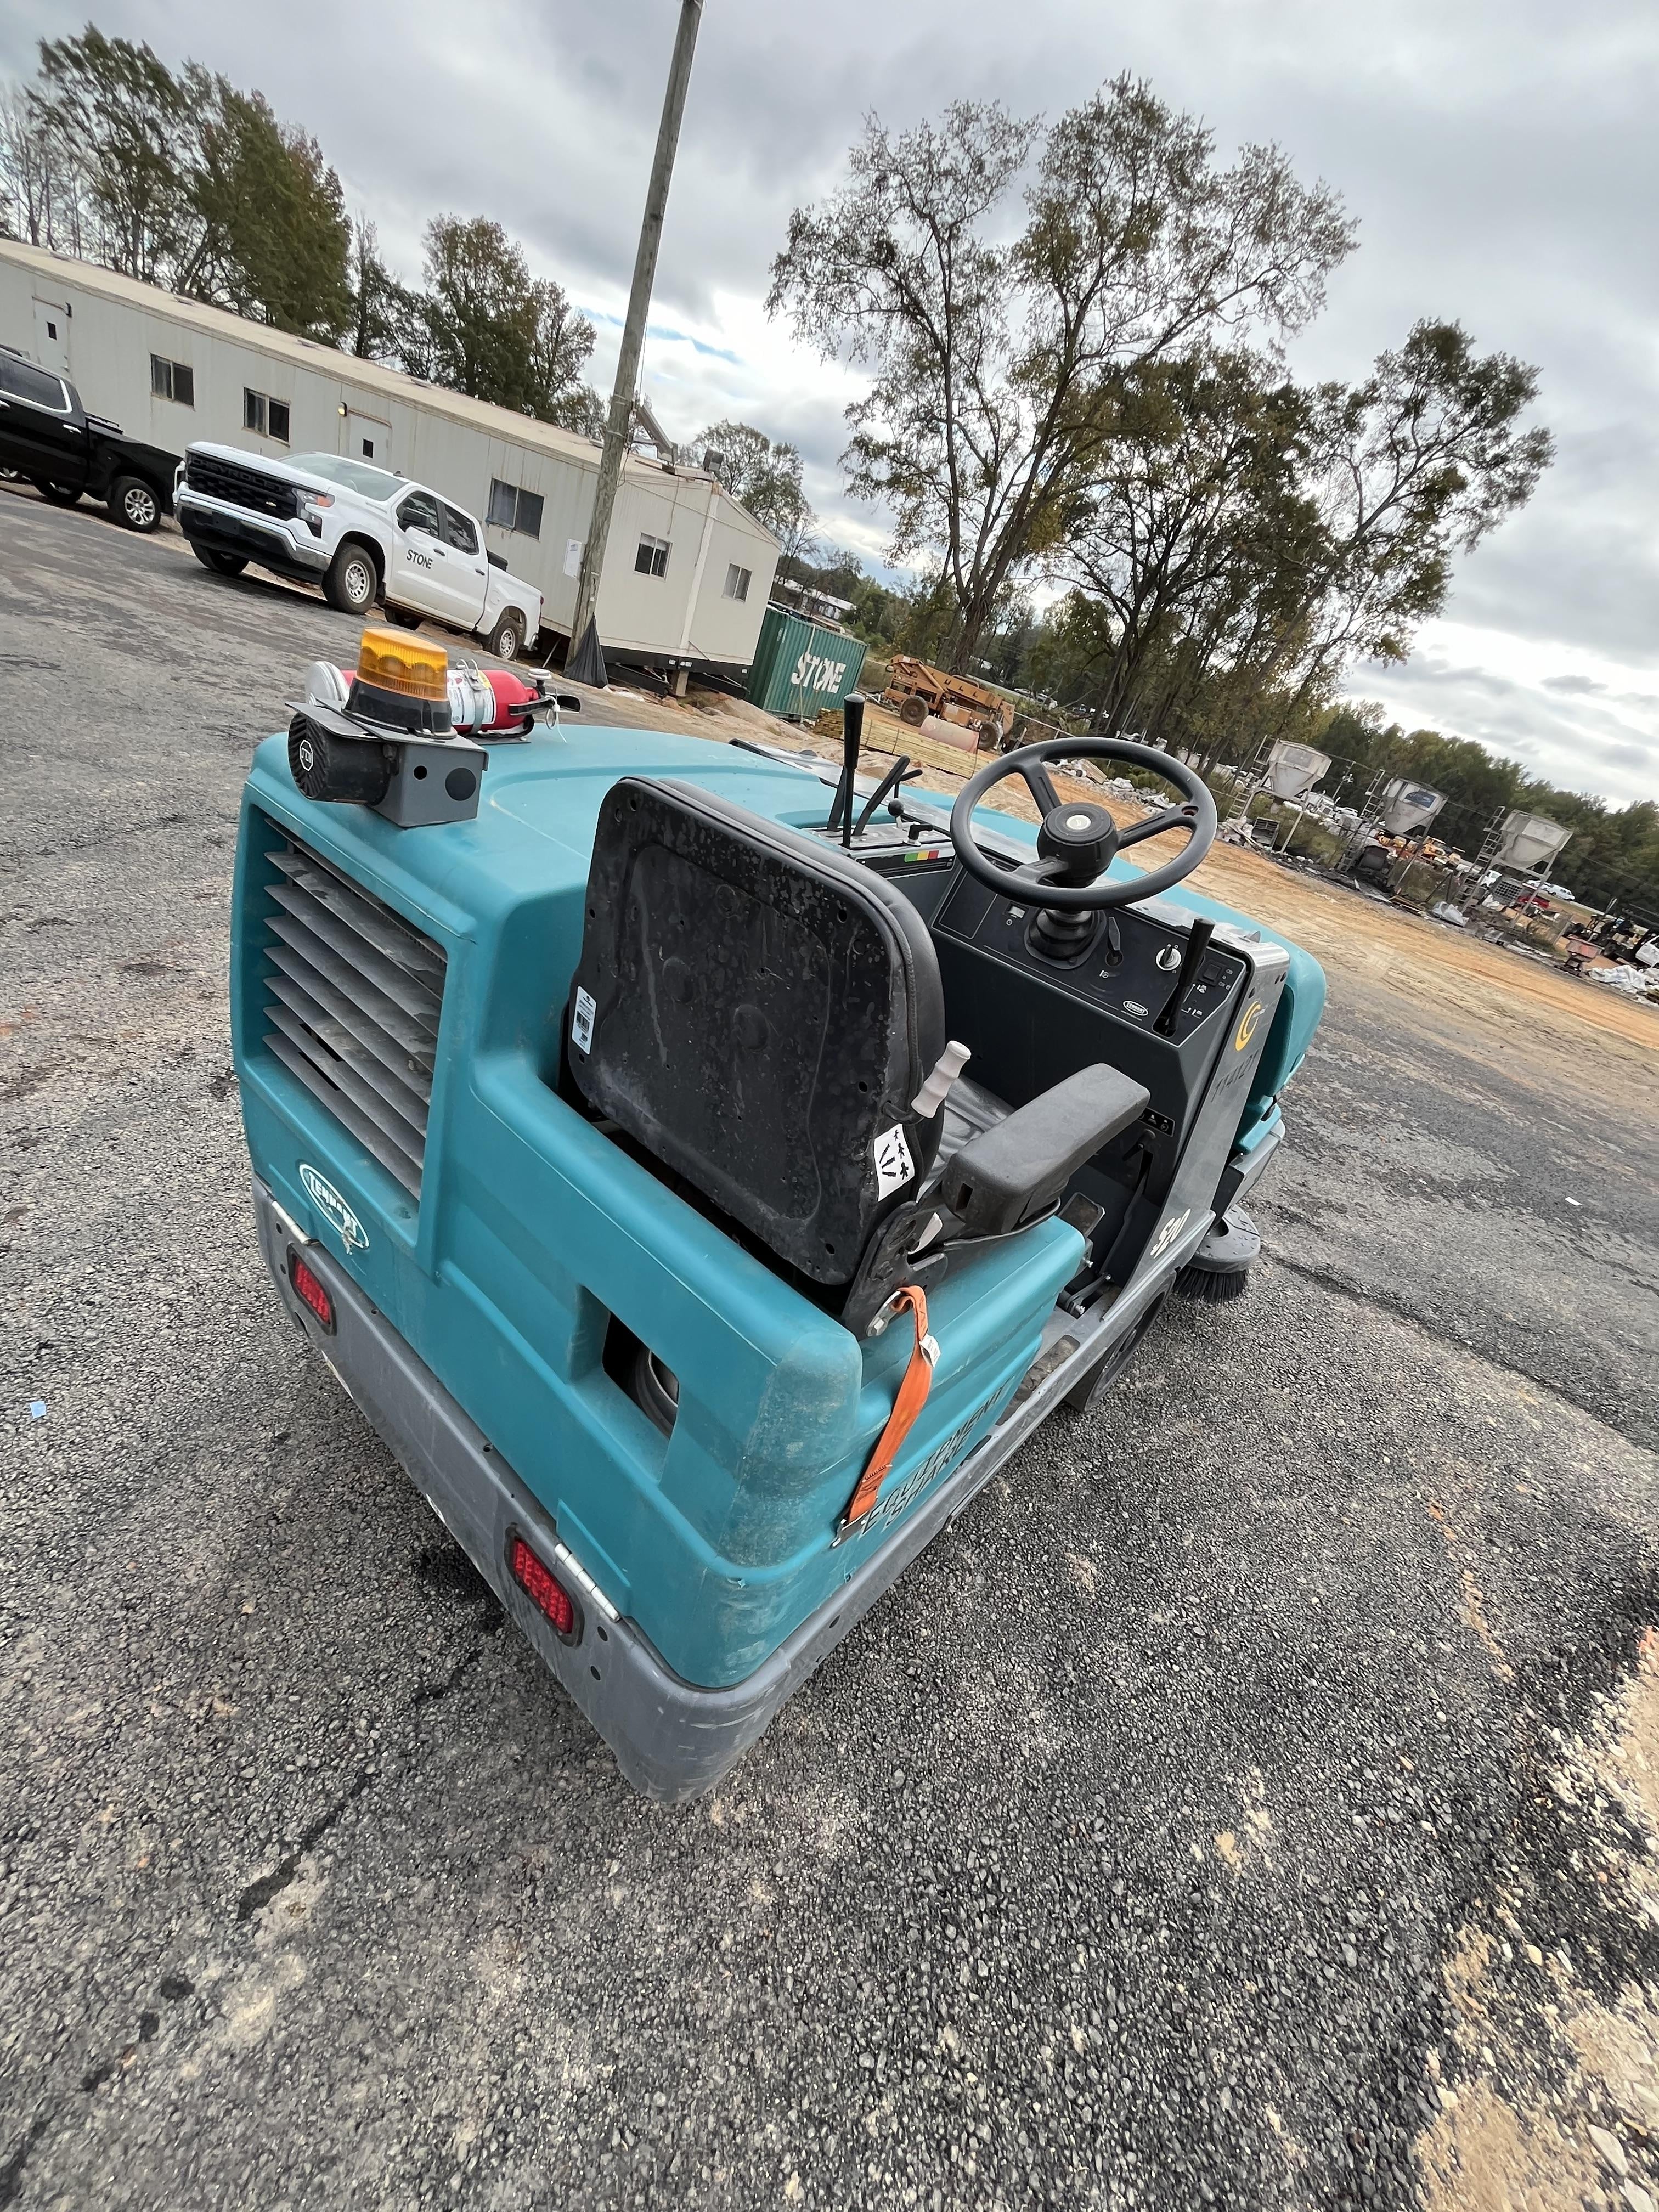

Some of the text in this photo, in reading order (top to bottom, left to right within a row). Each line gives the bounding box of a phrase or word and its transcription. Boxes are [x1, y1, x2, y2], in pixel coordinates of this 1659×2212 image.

[407, 549, 433, 569] STONE
[791, 651, 847, 693] STONE
[1150, 1209, 1190, 1259] S20
[862, 1375, 1012, 1535] EQUIPMENT
[885, 1429, 973, 1526] SHARE
